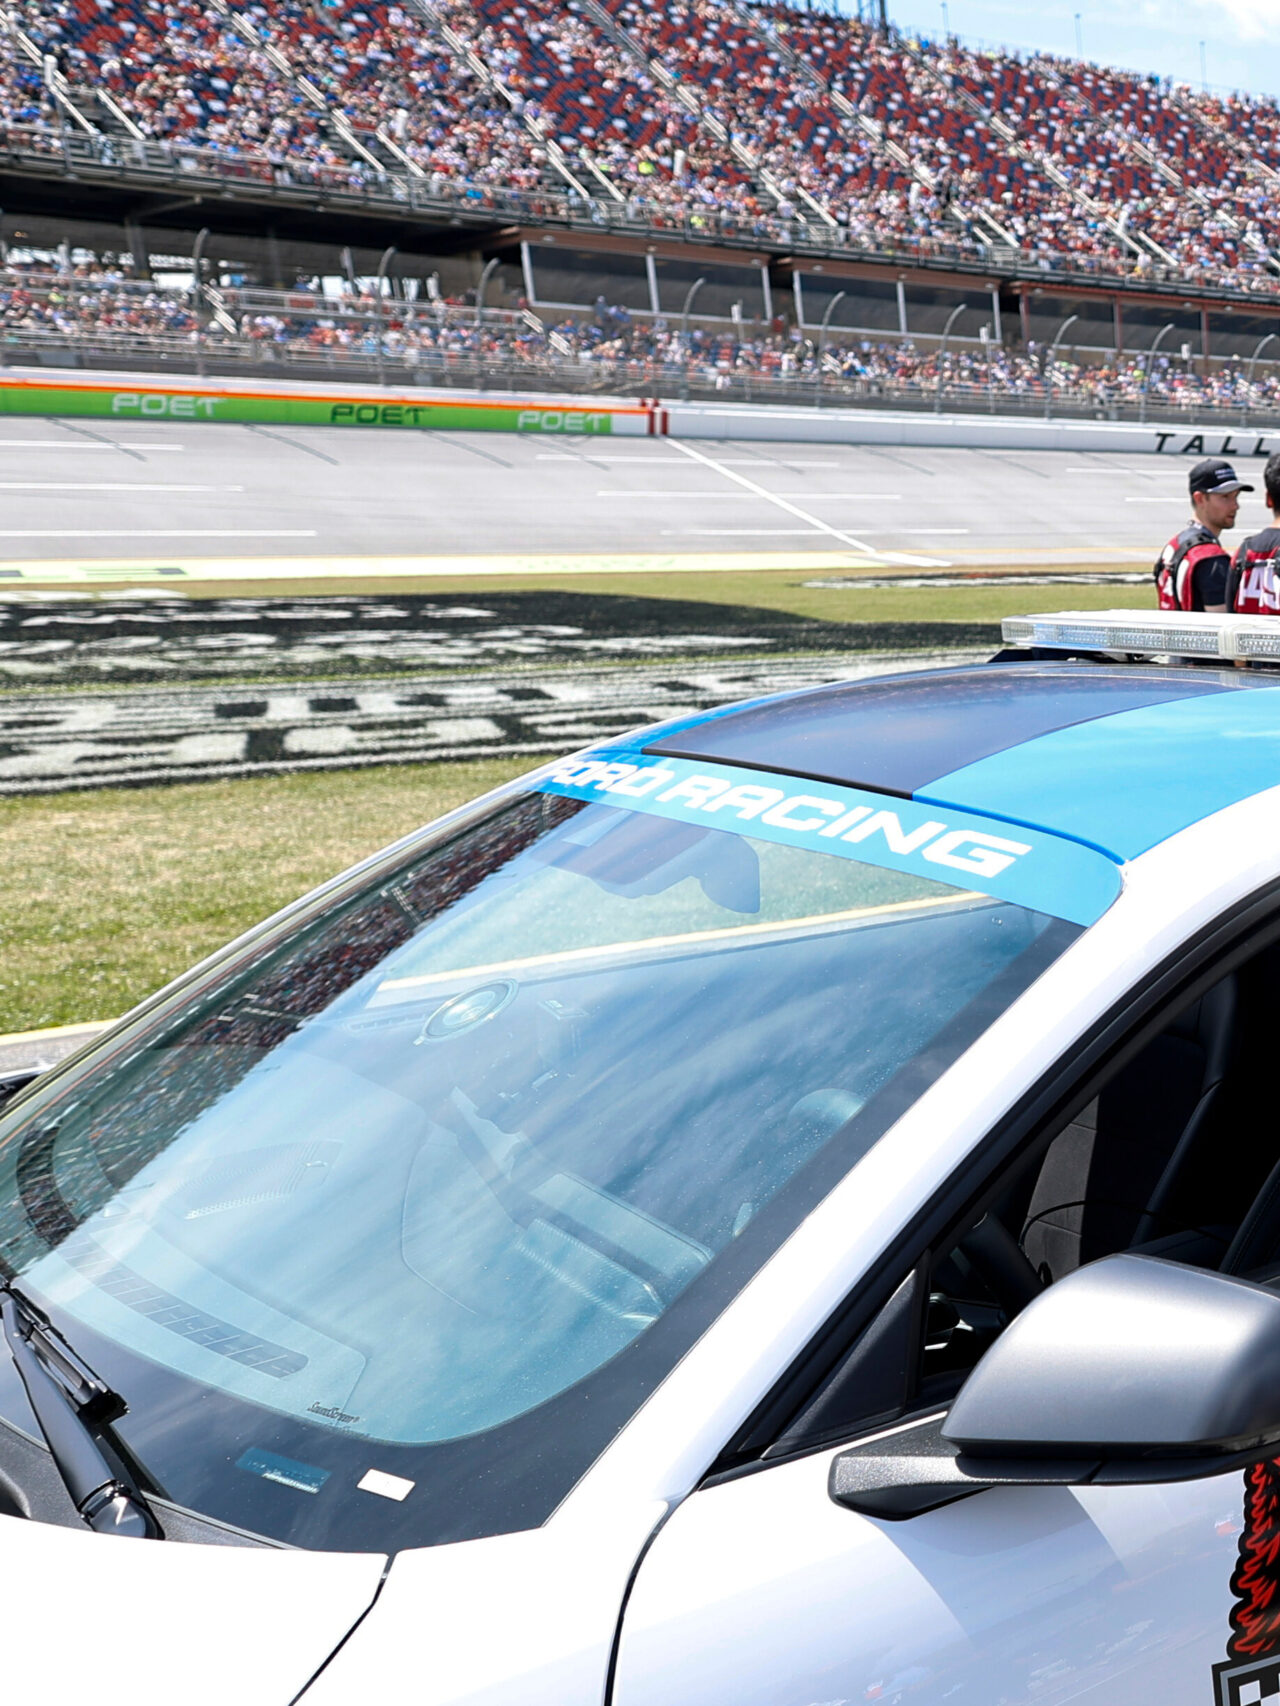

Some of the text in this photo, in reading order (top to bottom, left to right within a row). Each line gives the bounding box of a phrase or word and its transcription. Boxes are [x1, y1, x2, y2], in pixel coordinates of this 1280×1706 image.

[112, 393, 226, 417] POET
[331, 404, 430, 425] POET
[517, 411, 607, 432] POET
[549, 760, 1033, 878] FORD RACING
